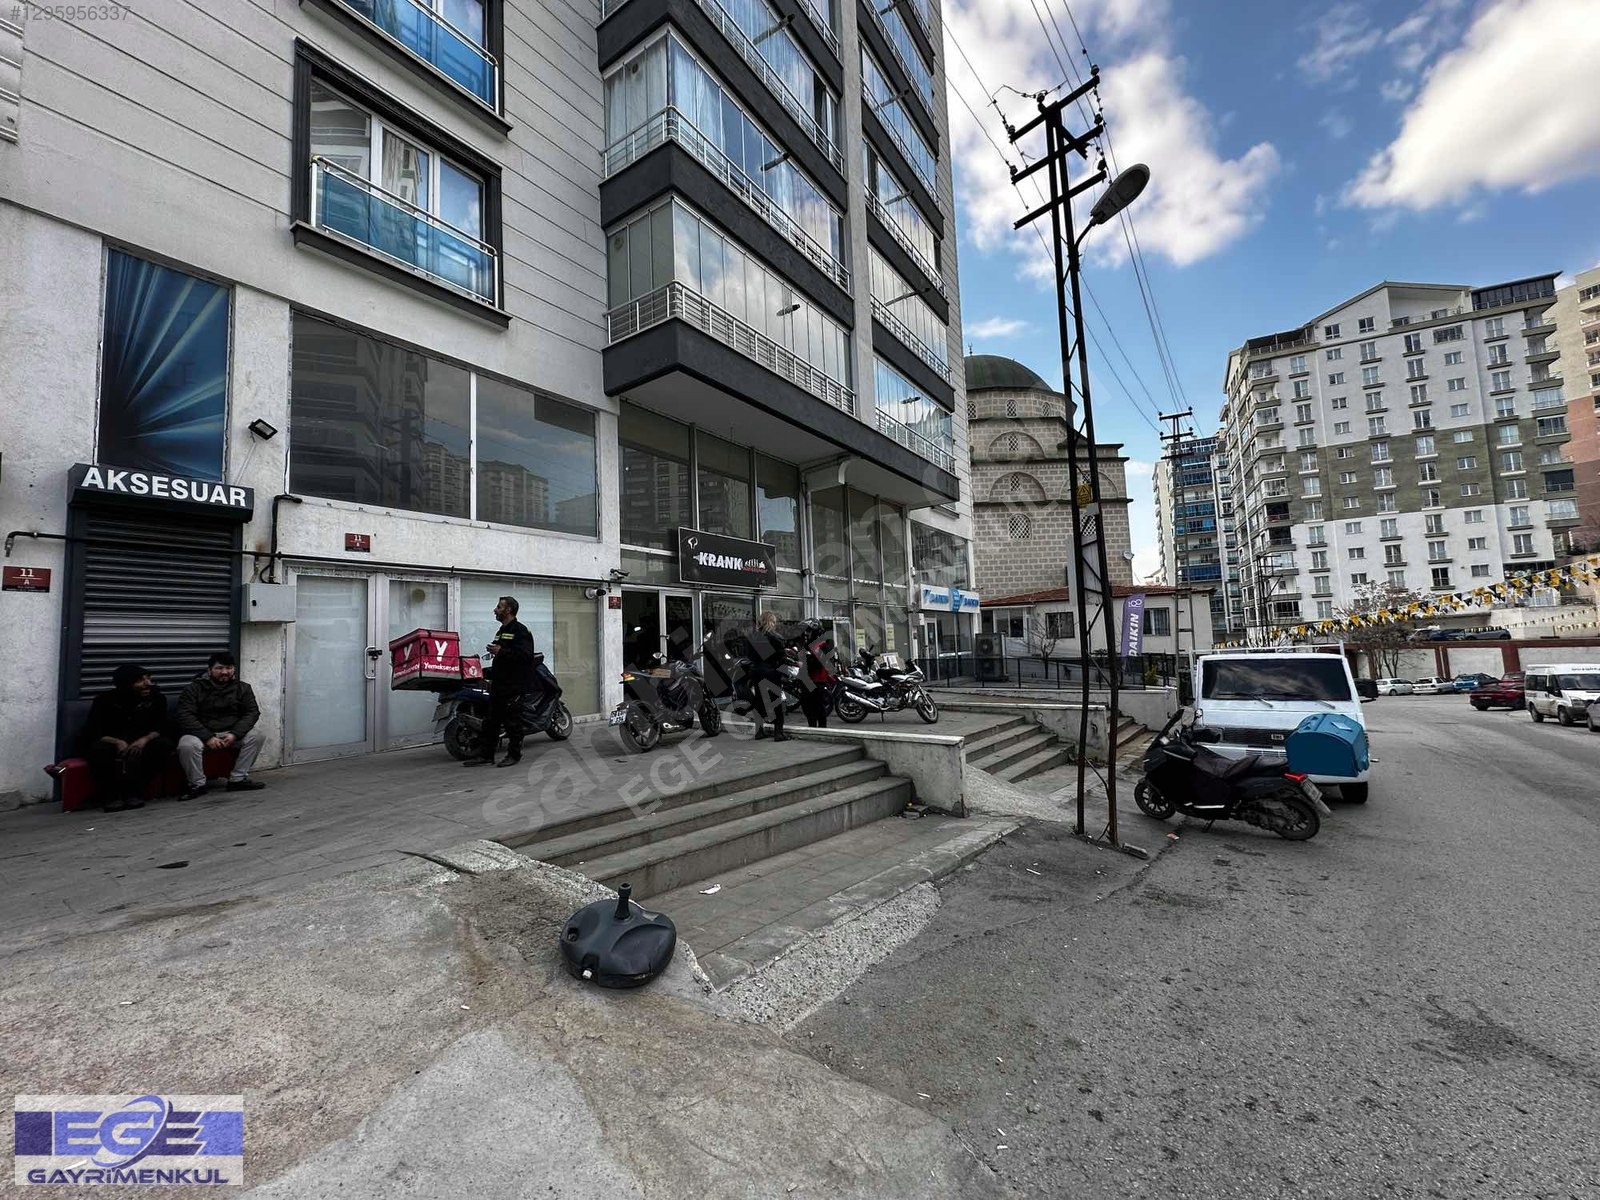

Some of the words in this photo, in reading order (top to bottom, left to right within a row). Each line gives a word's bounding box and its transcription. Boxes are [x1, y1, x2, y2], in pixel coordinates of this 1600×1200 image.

[81, 467, 246, 507] AKSESUAR
[20, 568, 35, 577] 11
[698, 551, 743, 571] KRANK
[1128, 613, 1139, 657] DAIKIN
